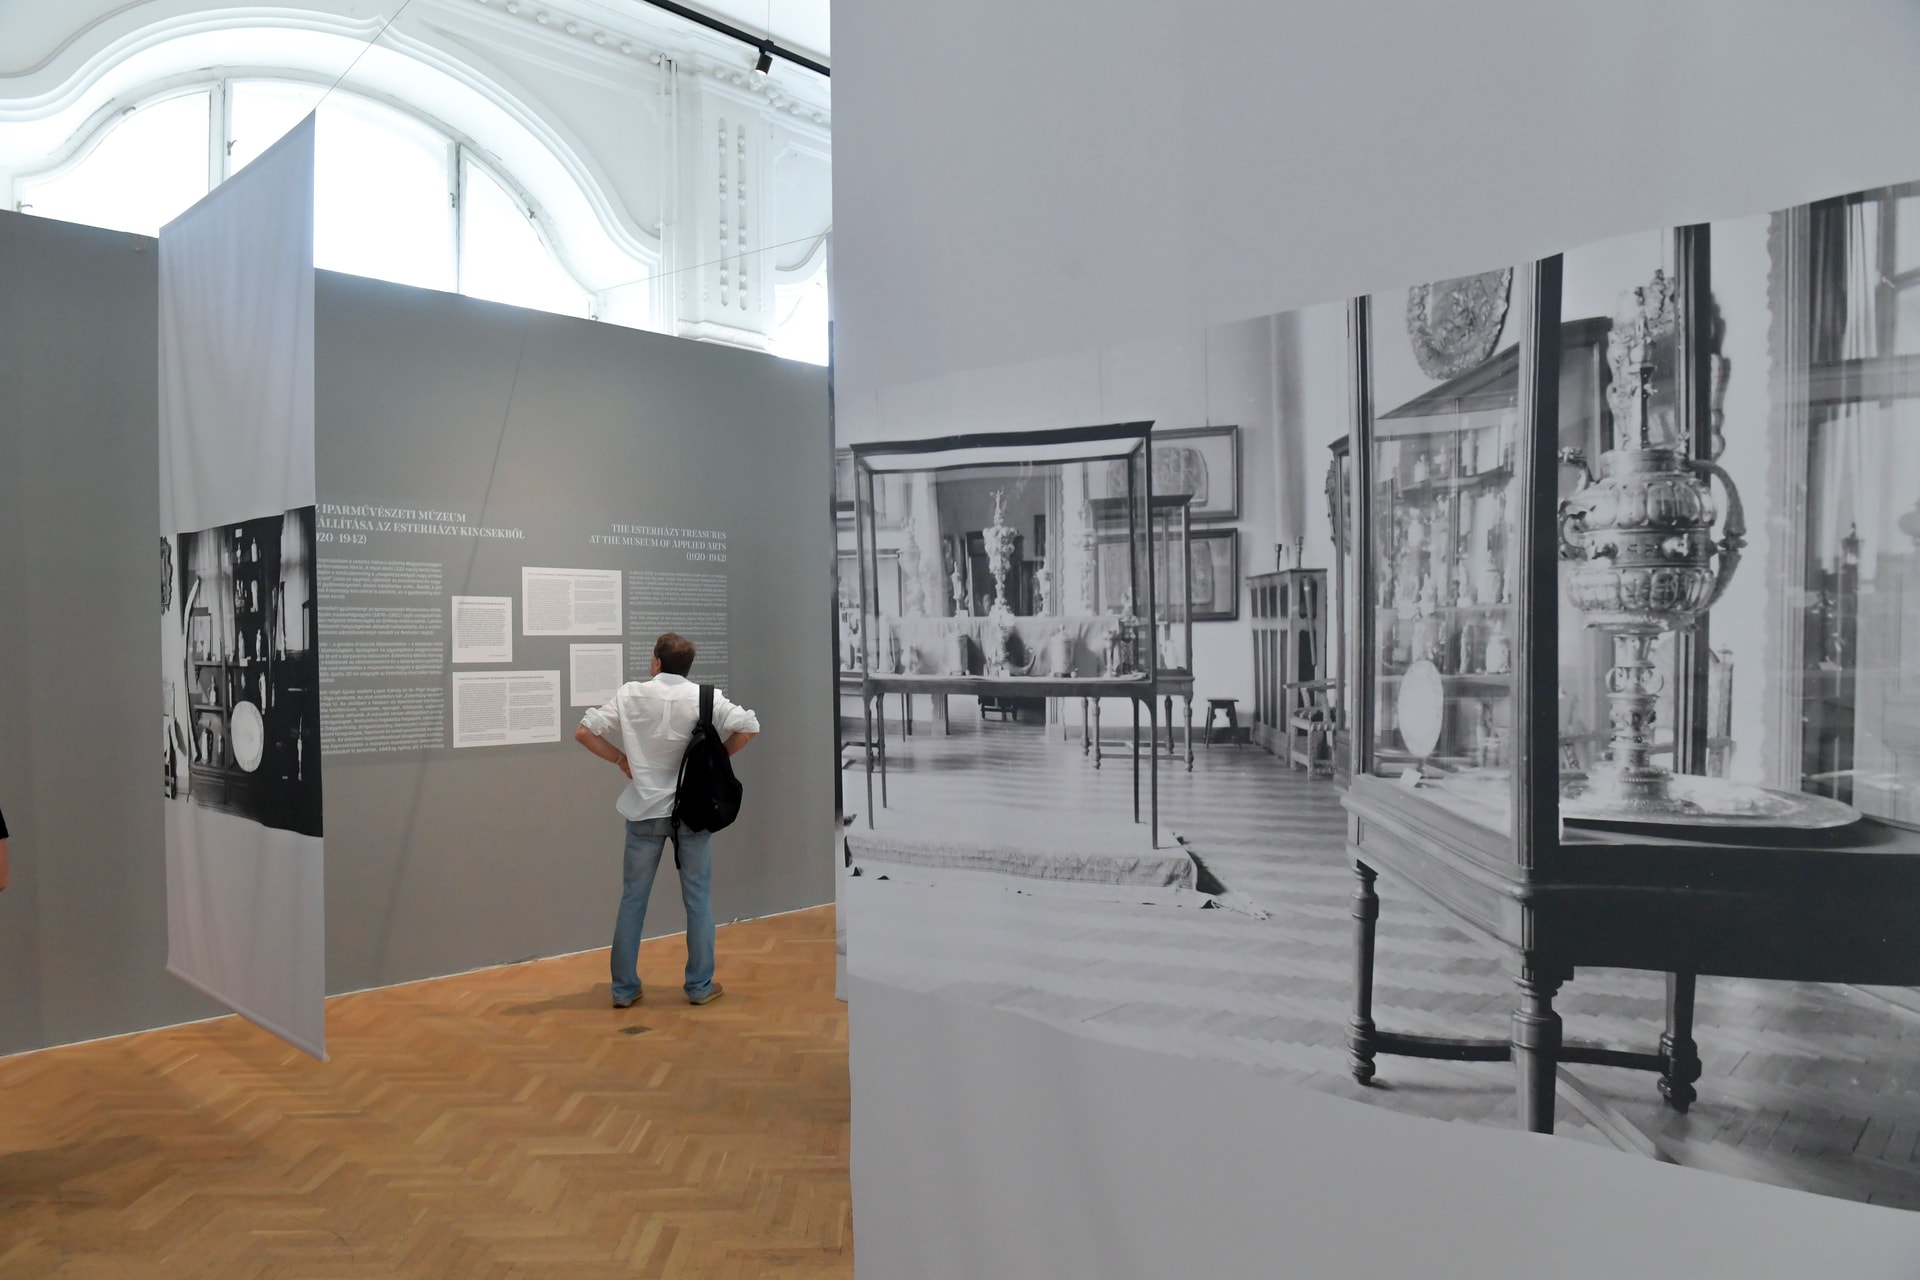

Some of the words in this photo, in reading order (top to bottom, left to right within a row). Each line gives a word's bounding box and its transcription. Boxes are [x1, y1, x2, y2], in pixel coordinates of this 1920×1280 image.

[322, 504, 416, 519] IPARMŰVÉSZETI
[418, 509, 467, 522] MÚZEUM
[316, 515, 373, 531] ÁLLÍTÁSA
[376, 521, 391, 531] AZ
[394, 522, 458, 535] ESTERHÁZY
[460, 526, 525, 539] KINCSEKBŐL
[611, 524, 629, 533] THE
[681, 529, 726, 539] TREASURES
[589, 535, 601, 544] AT
[602, 535, 620, 544] THE
[622, 536, 658, 547] MUSEUM
[660, 539, 670, 548] OF
[672, 540, 705, 550] APPLIED
[706, 542, 726, 551] ARTS
